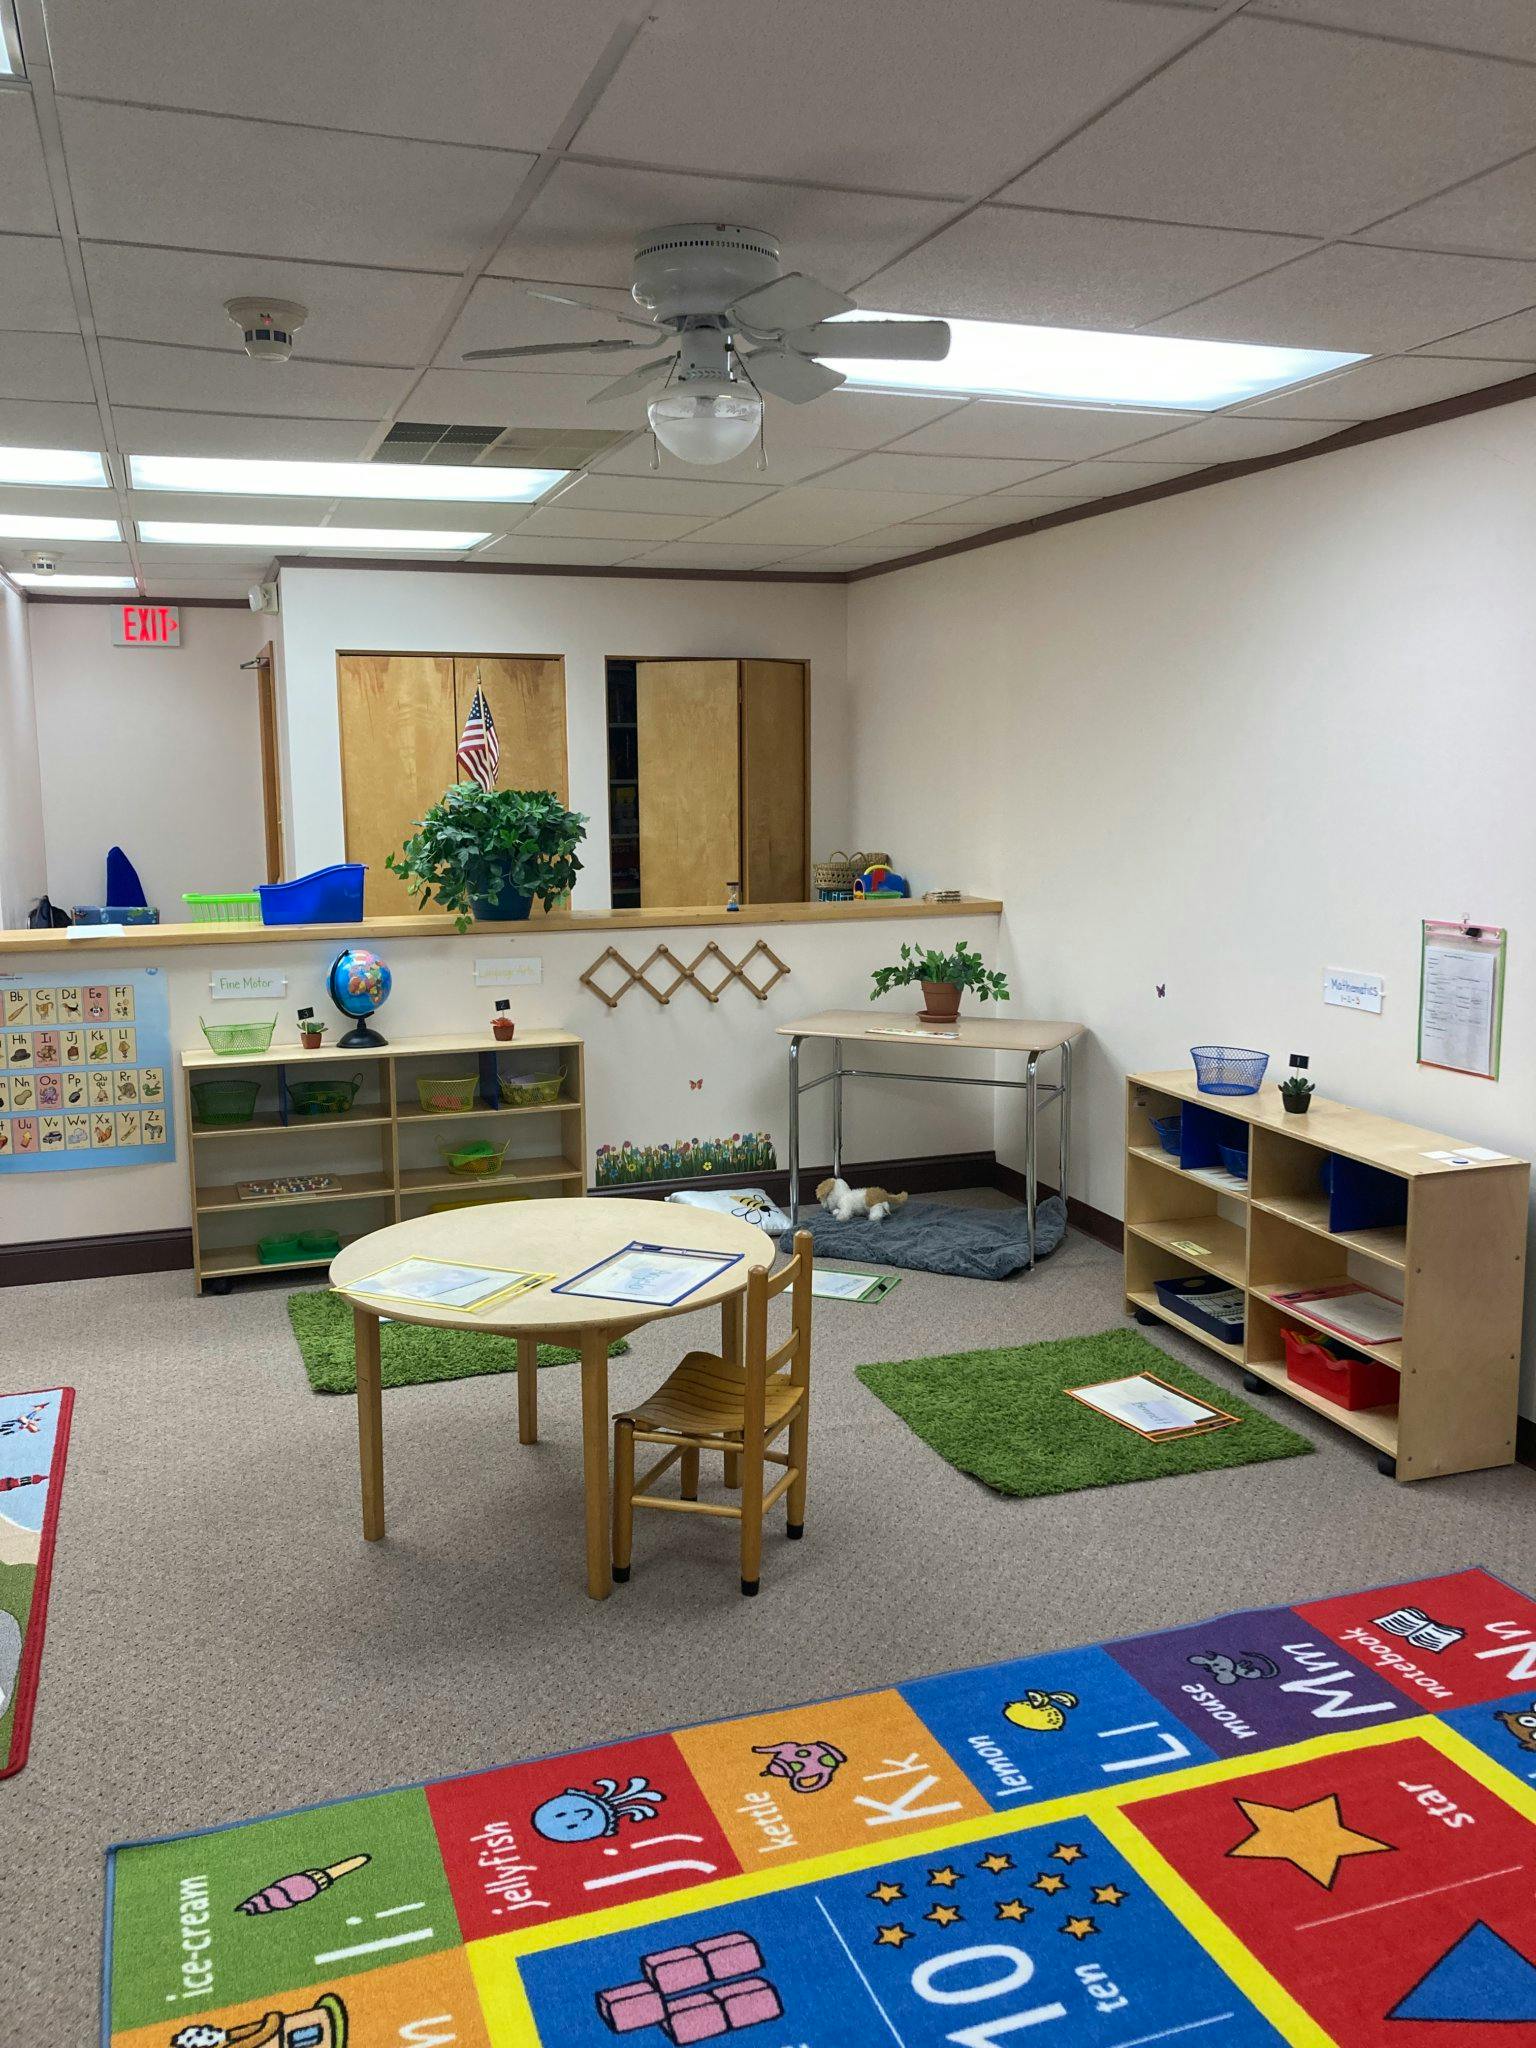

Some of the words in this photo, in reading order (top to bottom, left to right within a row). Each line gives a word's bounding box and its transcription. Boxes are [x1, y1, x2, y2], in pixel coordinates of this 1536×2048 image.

[123, 607, 168, 642] EXIT
[10, 991, 23, 1002] Bb
[36, 990, 51, 1000] Cc
[62, 989, 77, 999] Dd
[89, 988, 102, 999] Ee
[115, 987, 127, 998] Ff
[220, 978, 240, 989] Fine
[243, 977, 271, 989] Motor
[12, 1034, 27, 1044] Hh
[41, 1032, 52, 1043] Ii
[67, 1031, 78, 1044] Jj
[91, 1030, 104, 1041] Kk
[14, 1077, 30, 1087] Nn
[40, 1075, 57, 1085] Oo
[68, 1074, 81, 1087] Pp
[120, 1071, 131, 1082] Rr
[146, 1070, 157, 1080] Ss
[18, 1119, 32, 1129] Uu
[44, 1117, 58, 1127] Vv
[67, 1116, 87, 1126] Ww
[96, 1114, 110, 1125] Xx
[122, 1112, 135, 1126] Yy
[148, 1111, 160, 1122] Zz
[1280, 1641, 1398, 1719] Mm
[1338, 1625, 1454, 1700] notebook
[1180, 1681, 1258, 1740] mouse
[967, 1734, 1034, 1798] lemon
[1097, 1720, 1192, 1773] Ll
[853, 1752, 965, 1827] Kk
[1398, 1779, 1476, 1829] star
[736, 1791, 798, 1854] kettle
[470, 1820, 551, 1915] jellyfish
[583, 1833, 718, 1891] Jj
[166, 1874, 214, 2002] ice-cream
[314, 1901, 434, 1965] Ii
[911, 1944, 1067, 2048] 10
[1074, 1961, 1130, 2011] ten
